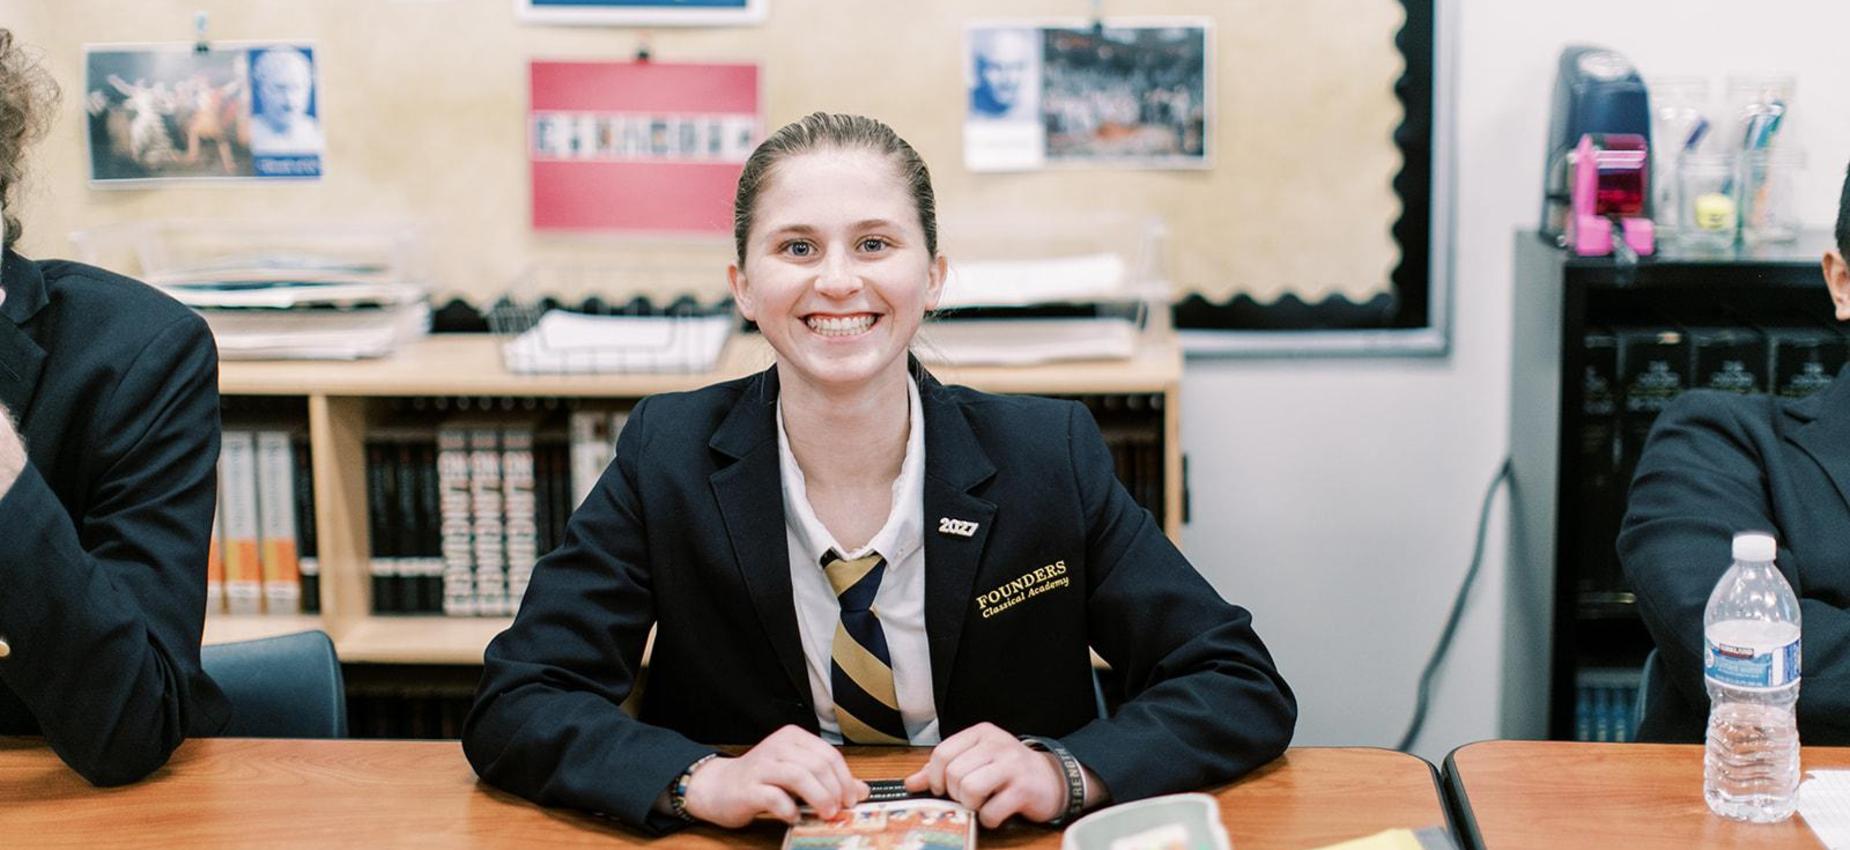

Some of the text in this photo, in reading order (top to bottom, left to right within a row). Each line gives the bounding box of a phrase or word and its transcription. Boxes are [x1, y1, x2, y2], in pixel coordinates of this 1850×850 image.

[938, 517, 979, 538] 2027
[976, 560, 1067, 610] FOUNDERS
[982, 576, 1069, 618] Classical Academy
